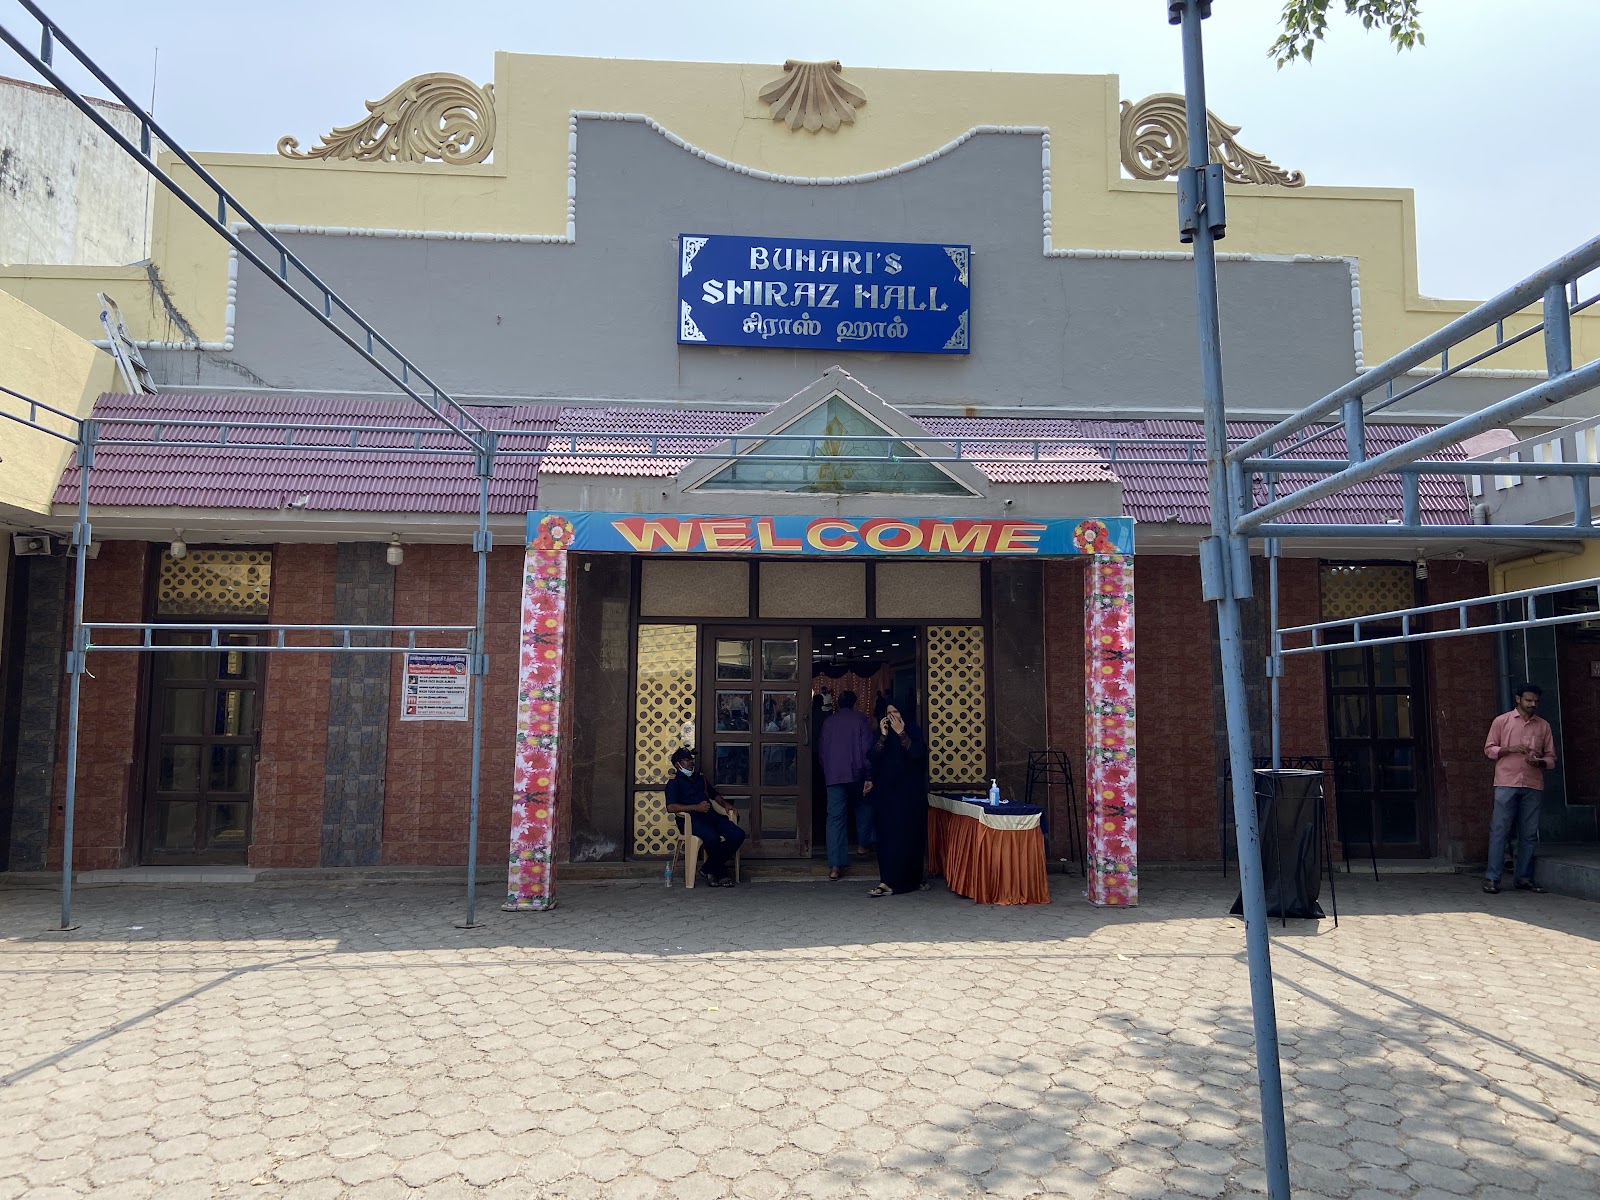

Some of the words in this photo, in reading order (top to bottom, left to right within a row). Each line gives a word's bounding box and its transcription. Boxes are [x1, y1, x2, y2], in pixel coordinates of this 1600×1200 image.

[750, 246, 903, 275] BUHARI'S
[702, 278, 840, 308] SHIRAZ
[854, 284, 949, 311] HALL
[742, 311, 822, 339] சிராஸ்
[836, 315, 909, 342] ஹால்
[611, 520, 1048, 553] WELCOME
